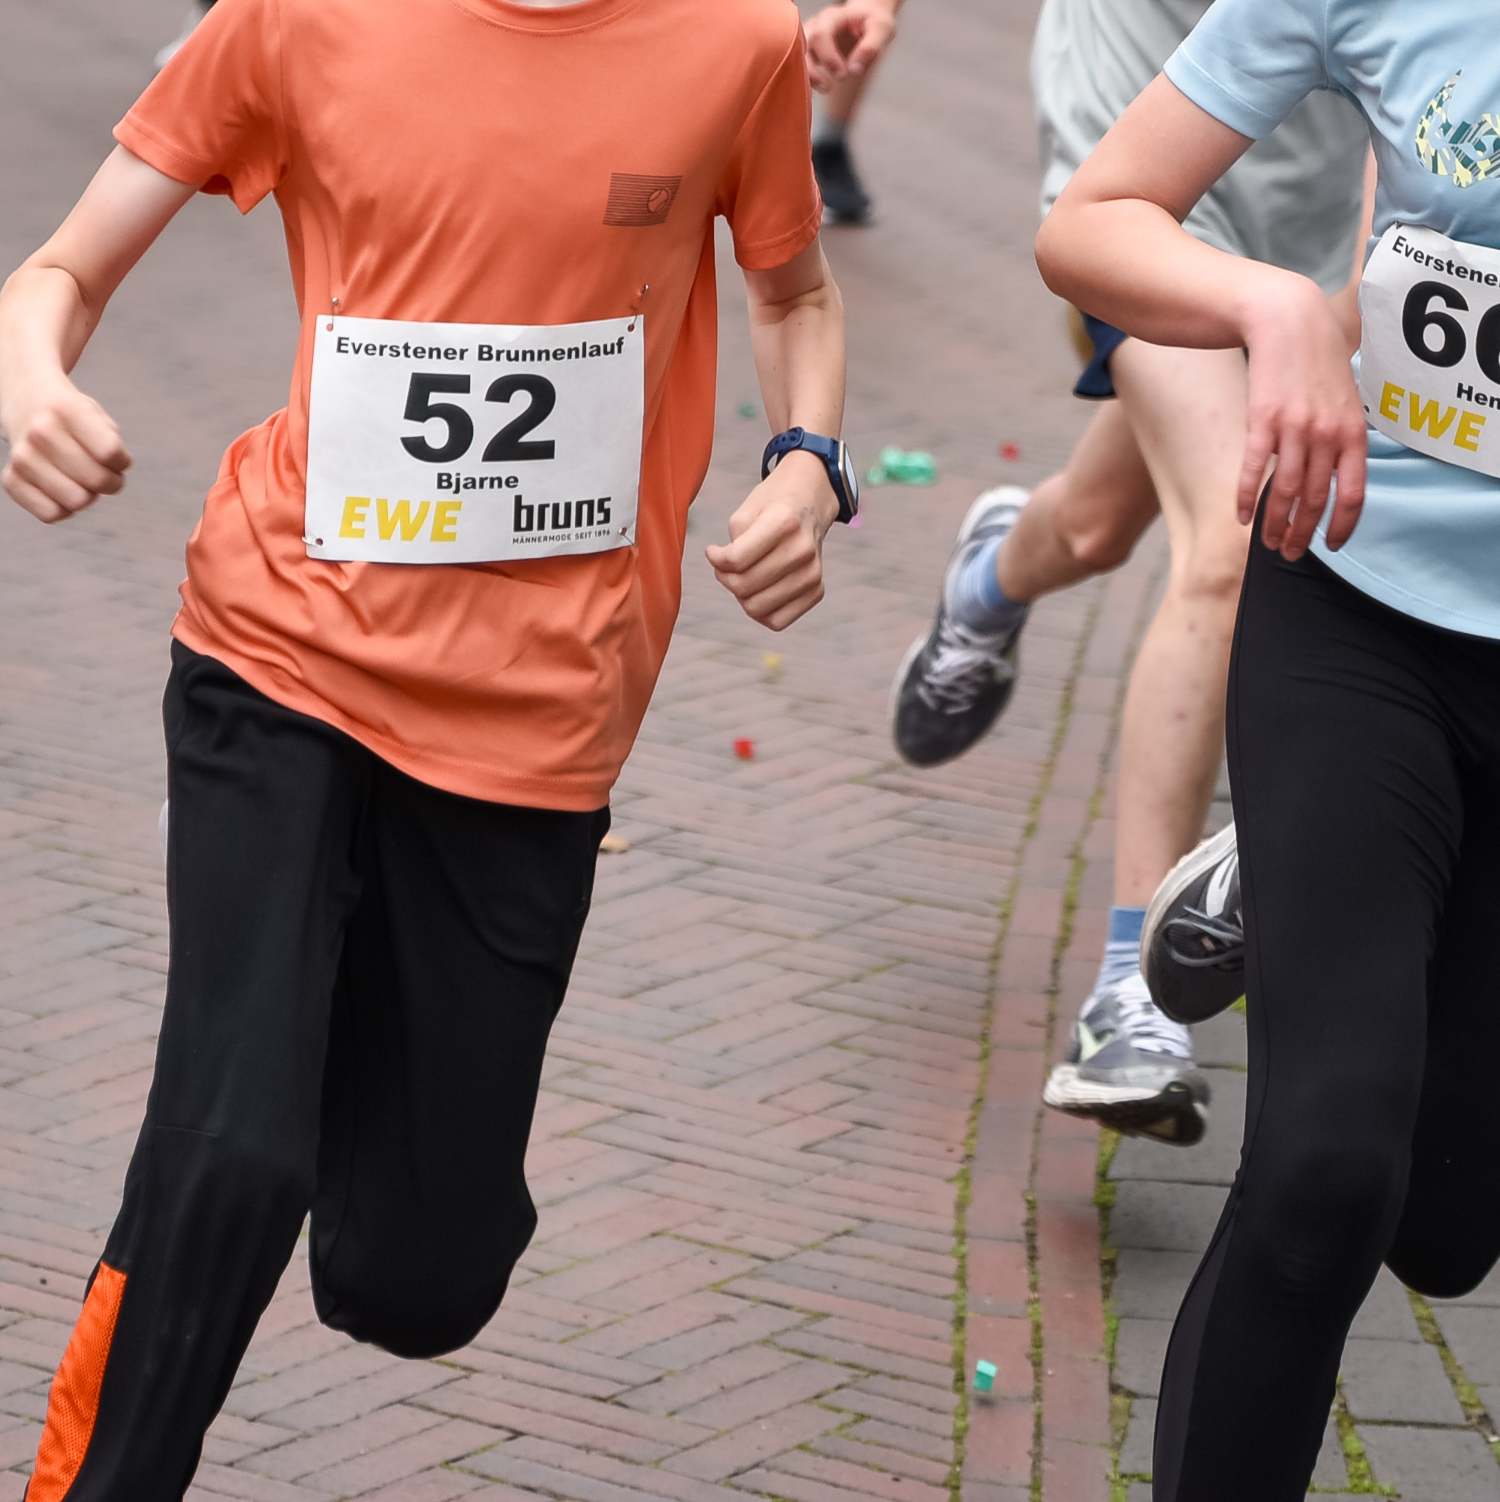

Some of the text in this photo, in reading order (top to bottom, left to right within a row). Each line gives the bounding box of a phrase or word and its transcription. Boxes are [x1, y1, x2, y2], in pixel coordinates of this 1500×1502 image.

[335, 336, 625, 363] Everstener Brunnenlauf
[399, 371, 557, 464] 52
[1378, 380, 1487, 453] EWE
[435, 472, 520, 495] Bjarne
[337, 496, 463, 543] EWE
[512, 494, 612, 533] bruns
[512, 528, 611, 545] MÄNNERMODE SEIT 1896
